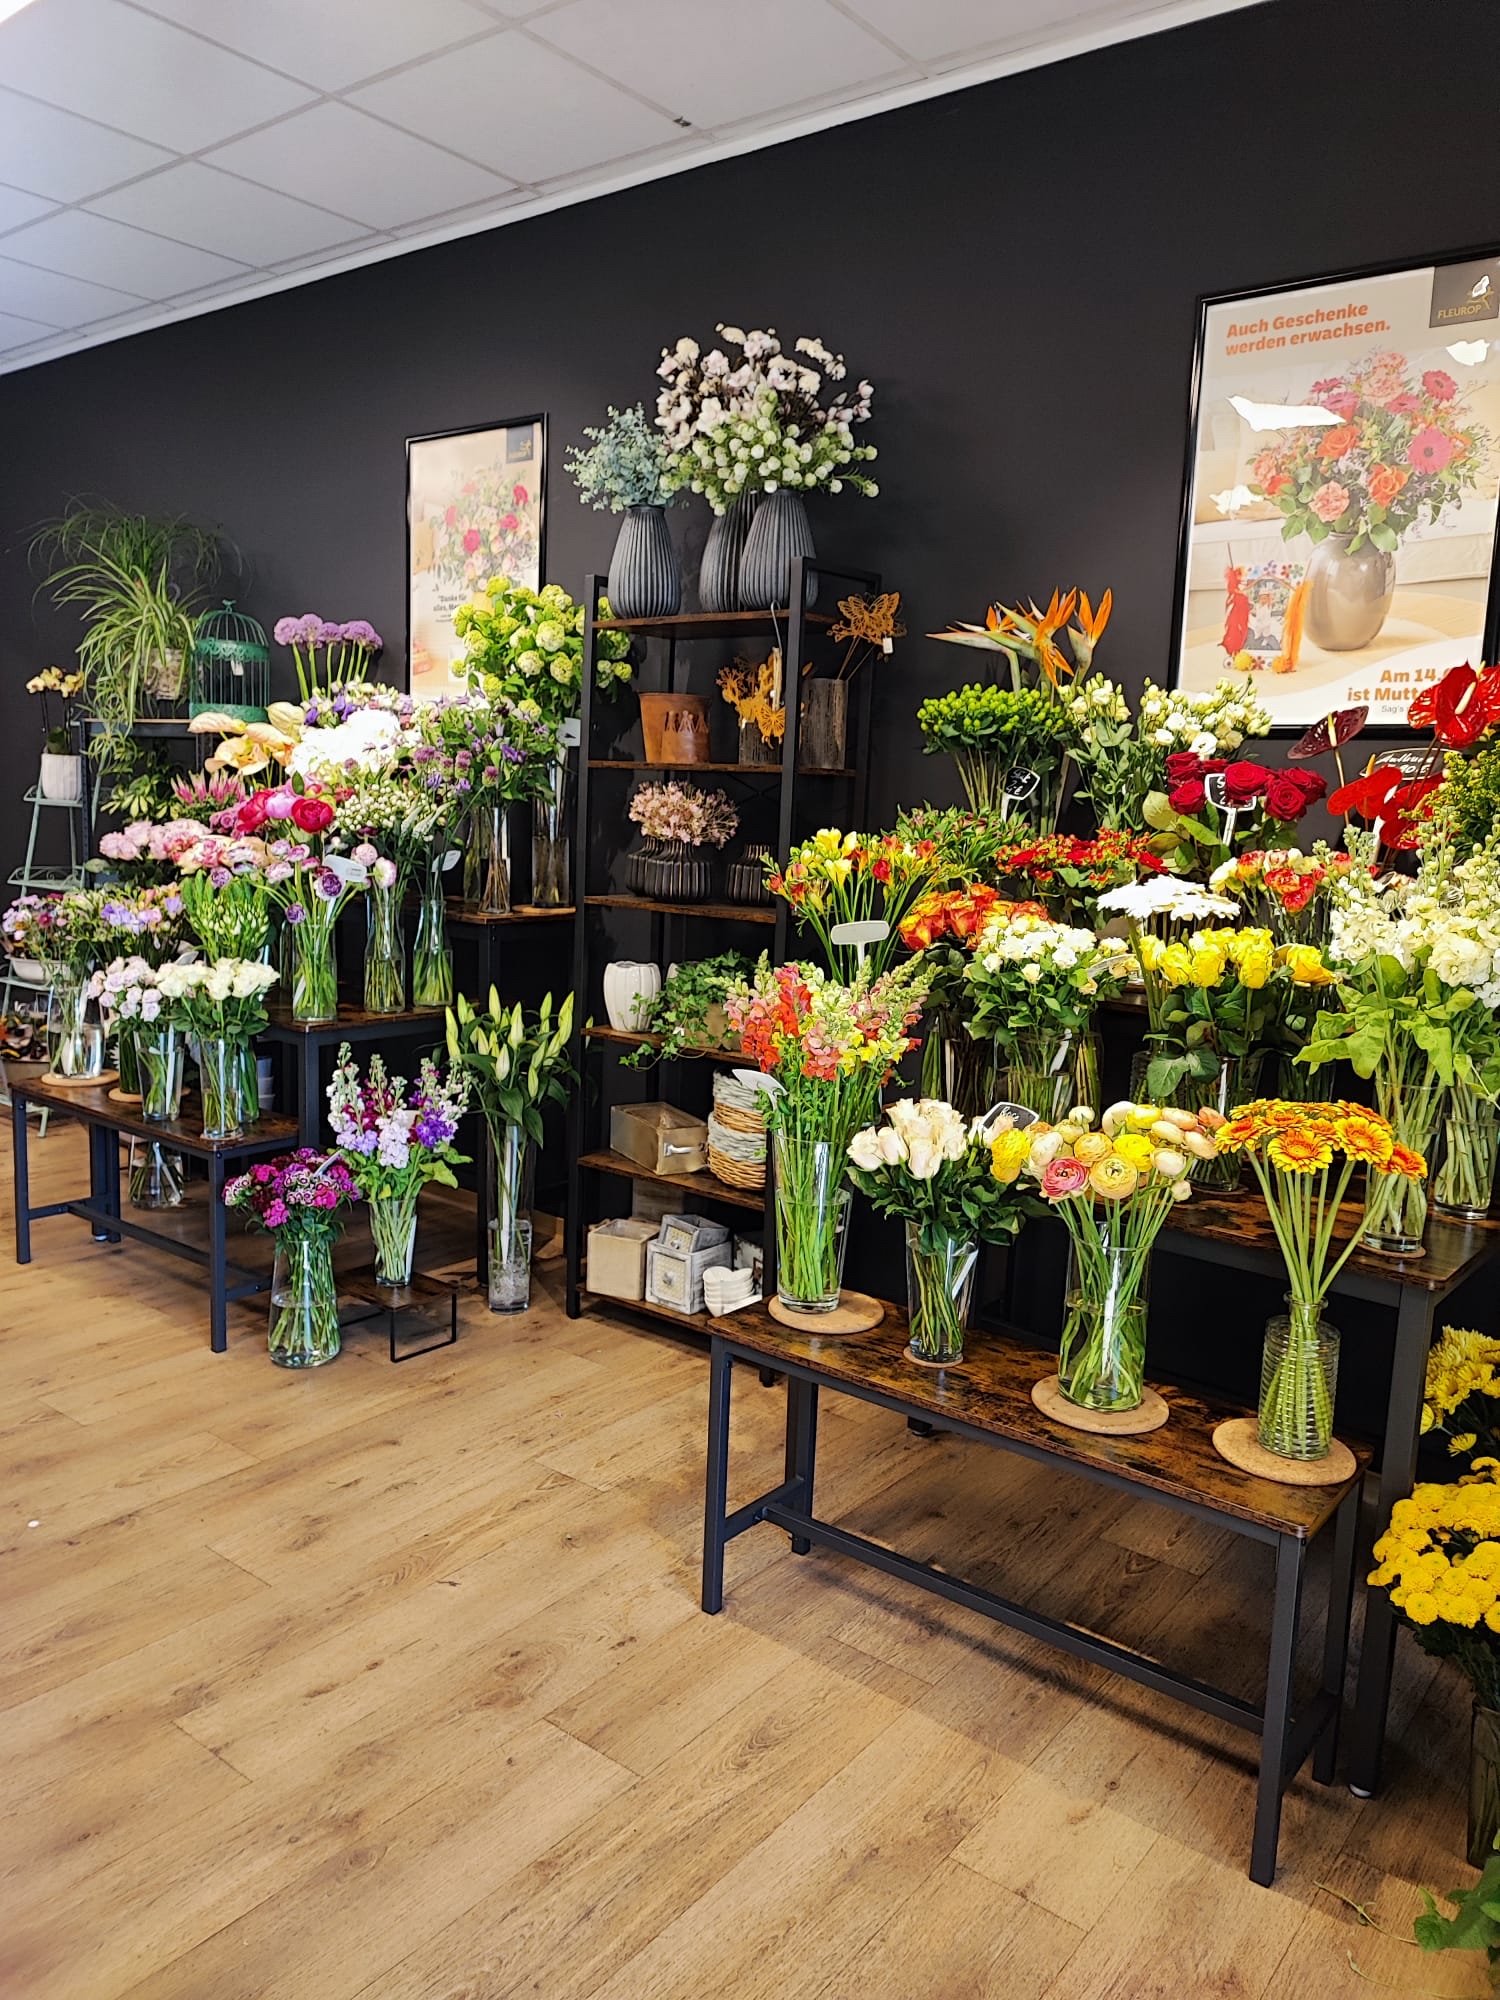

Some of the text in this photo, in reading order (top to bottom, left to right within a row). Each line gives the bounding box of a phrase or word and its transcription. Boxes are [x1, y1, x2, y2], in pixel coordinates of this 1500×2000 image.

[1438, 304, 1482, 319] FLEUROP
[1227, 303, 1369, 338] Auch Geschenke
[1225, 319, 1391, 356] werden erwachsen.
[1380, 668, 1450, 683] Am 14.
[1347, 687, 1418, 702] ist Mutt
